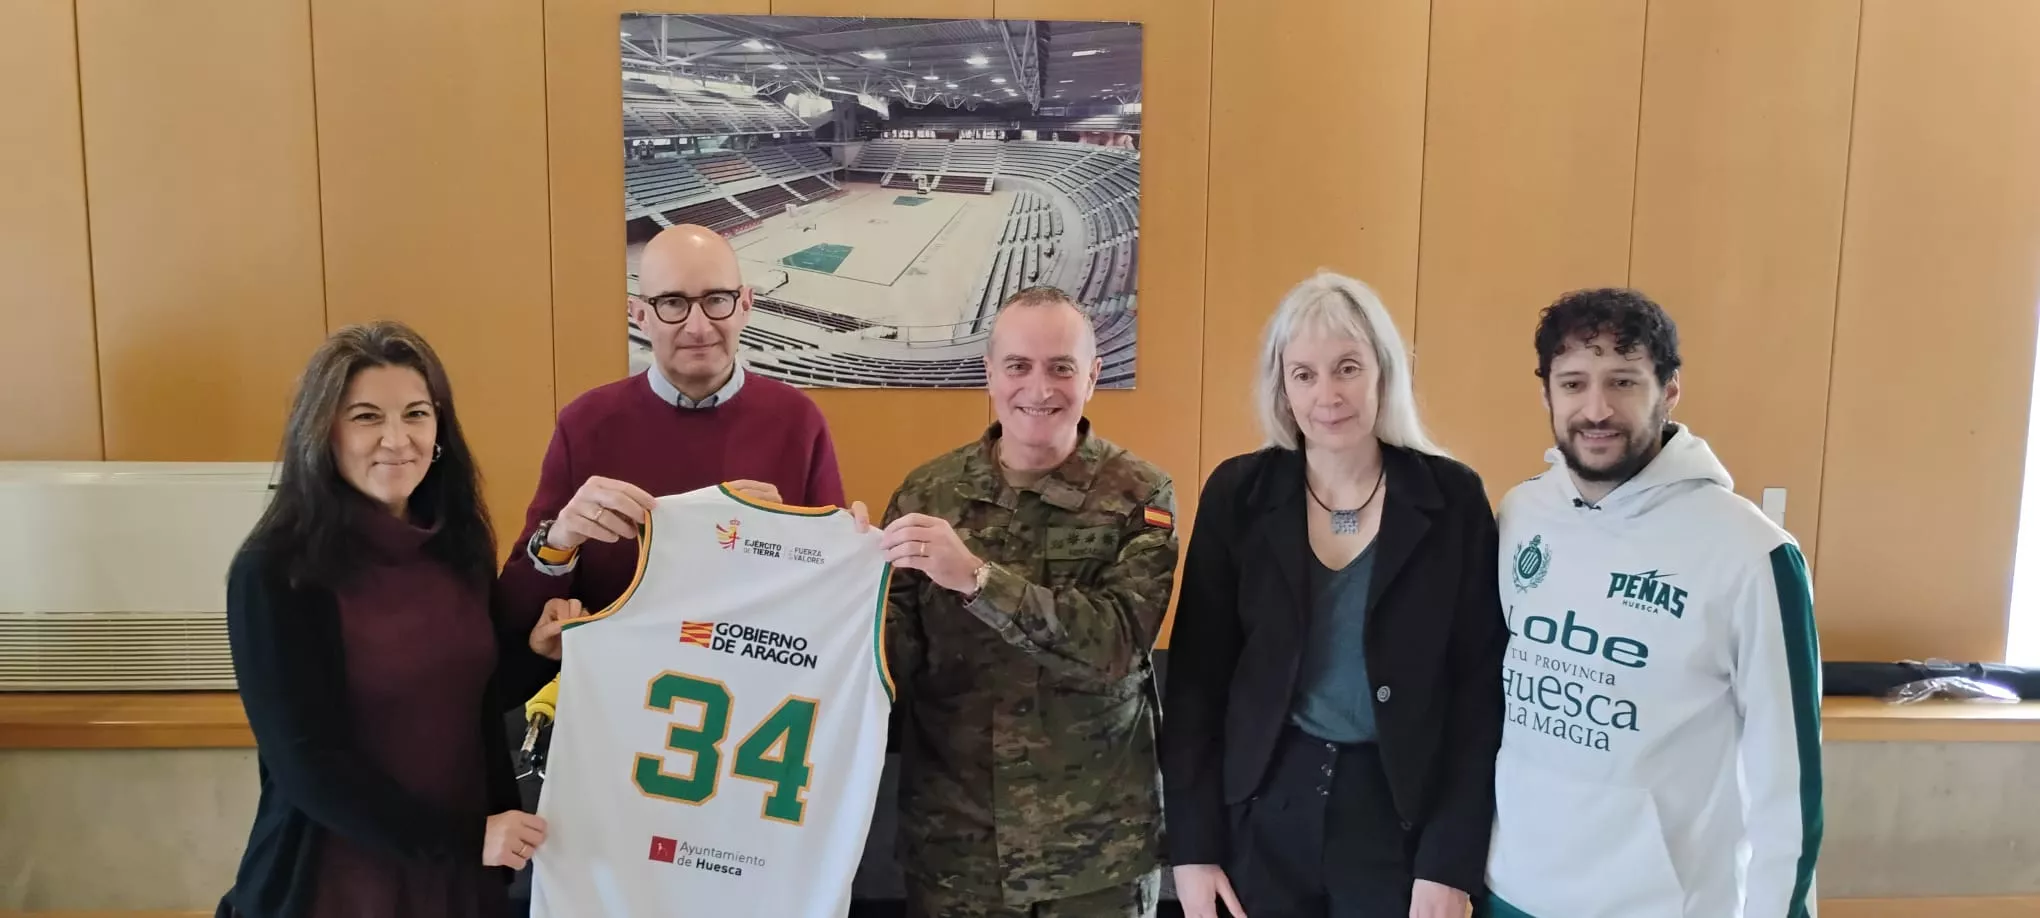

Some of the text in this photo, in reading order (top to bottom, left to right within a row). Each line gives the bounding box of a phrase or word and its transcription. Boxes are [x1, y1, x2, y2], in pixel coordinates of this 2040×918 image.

[744, 539, 782, 552] EJÉRCITO
[753, 547, 780, 558] TIERRA
[794, 546, 822, 558] FUERZA
[793, 554, 825, 565] VALORES
[1622, 600, 1659, 614] HUESCA
[715, 622, 808, 651] GOBIERNO
[711, 636, 818, 669] DE ARAGON
[631, 669, 820, 827] 34
[680, 841, 766, 868] Ayuntamiento
[677, 855, 742, 877] de Huesca
